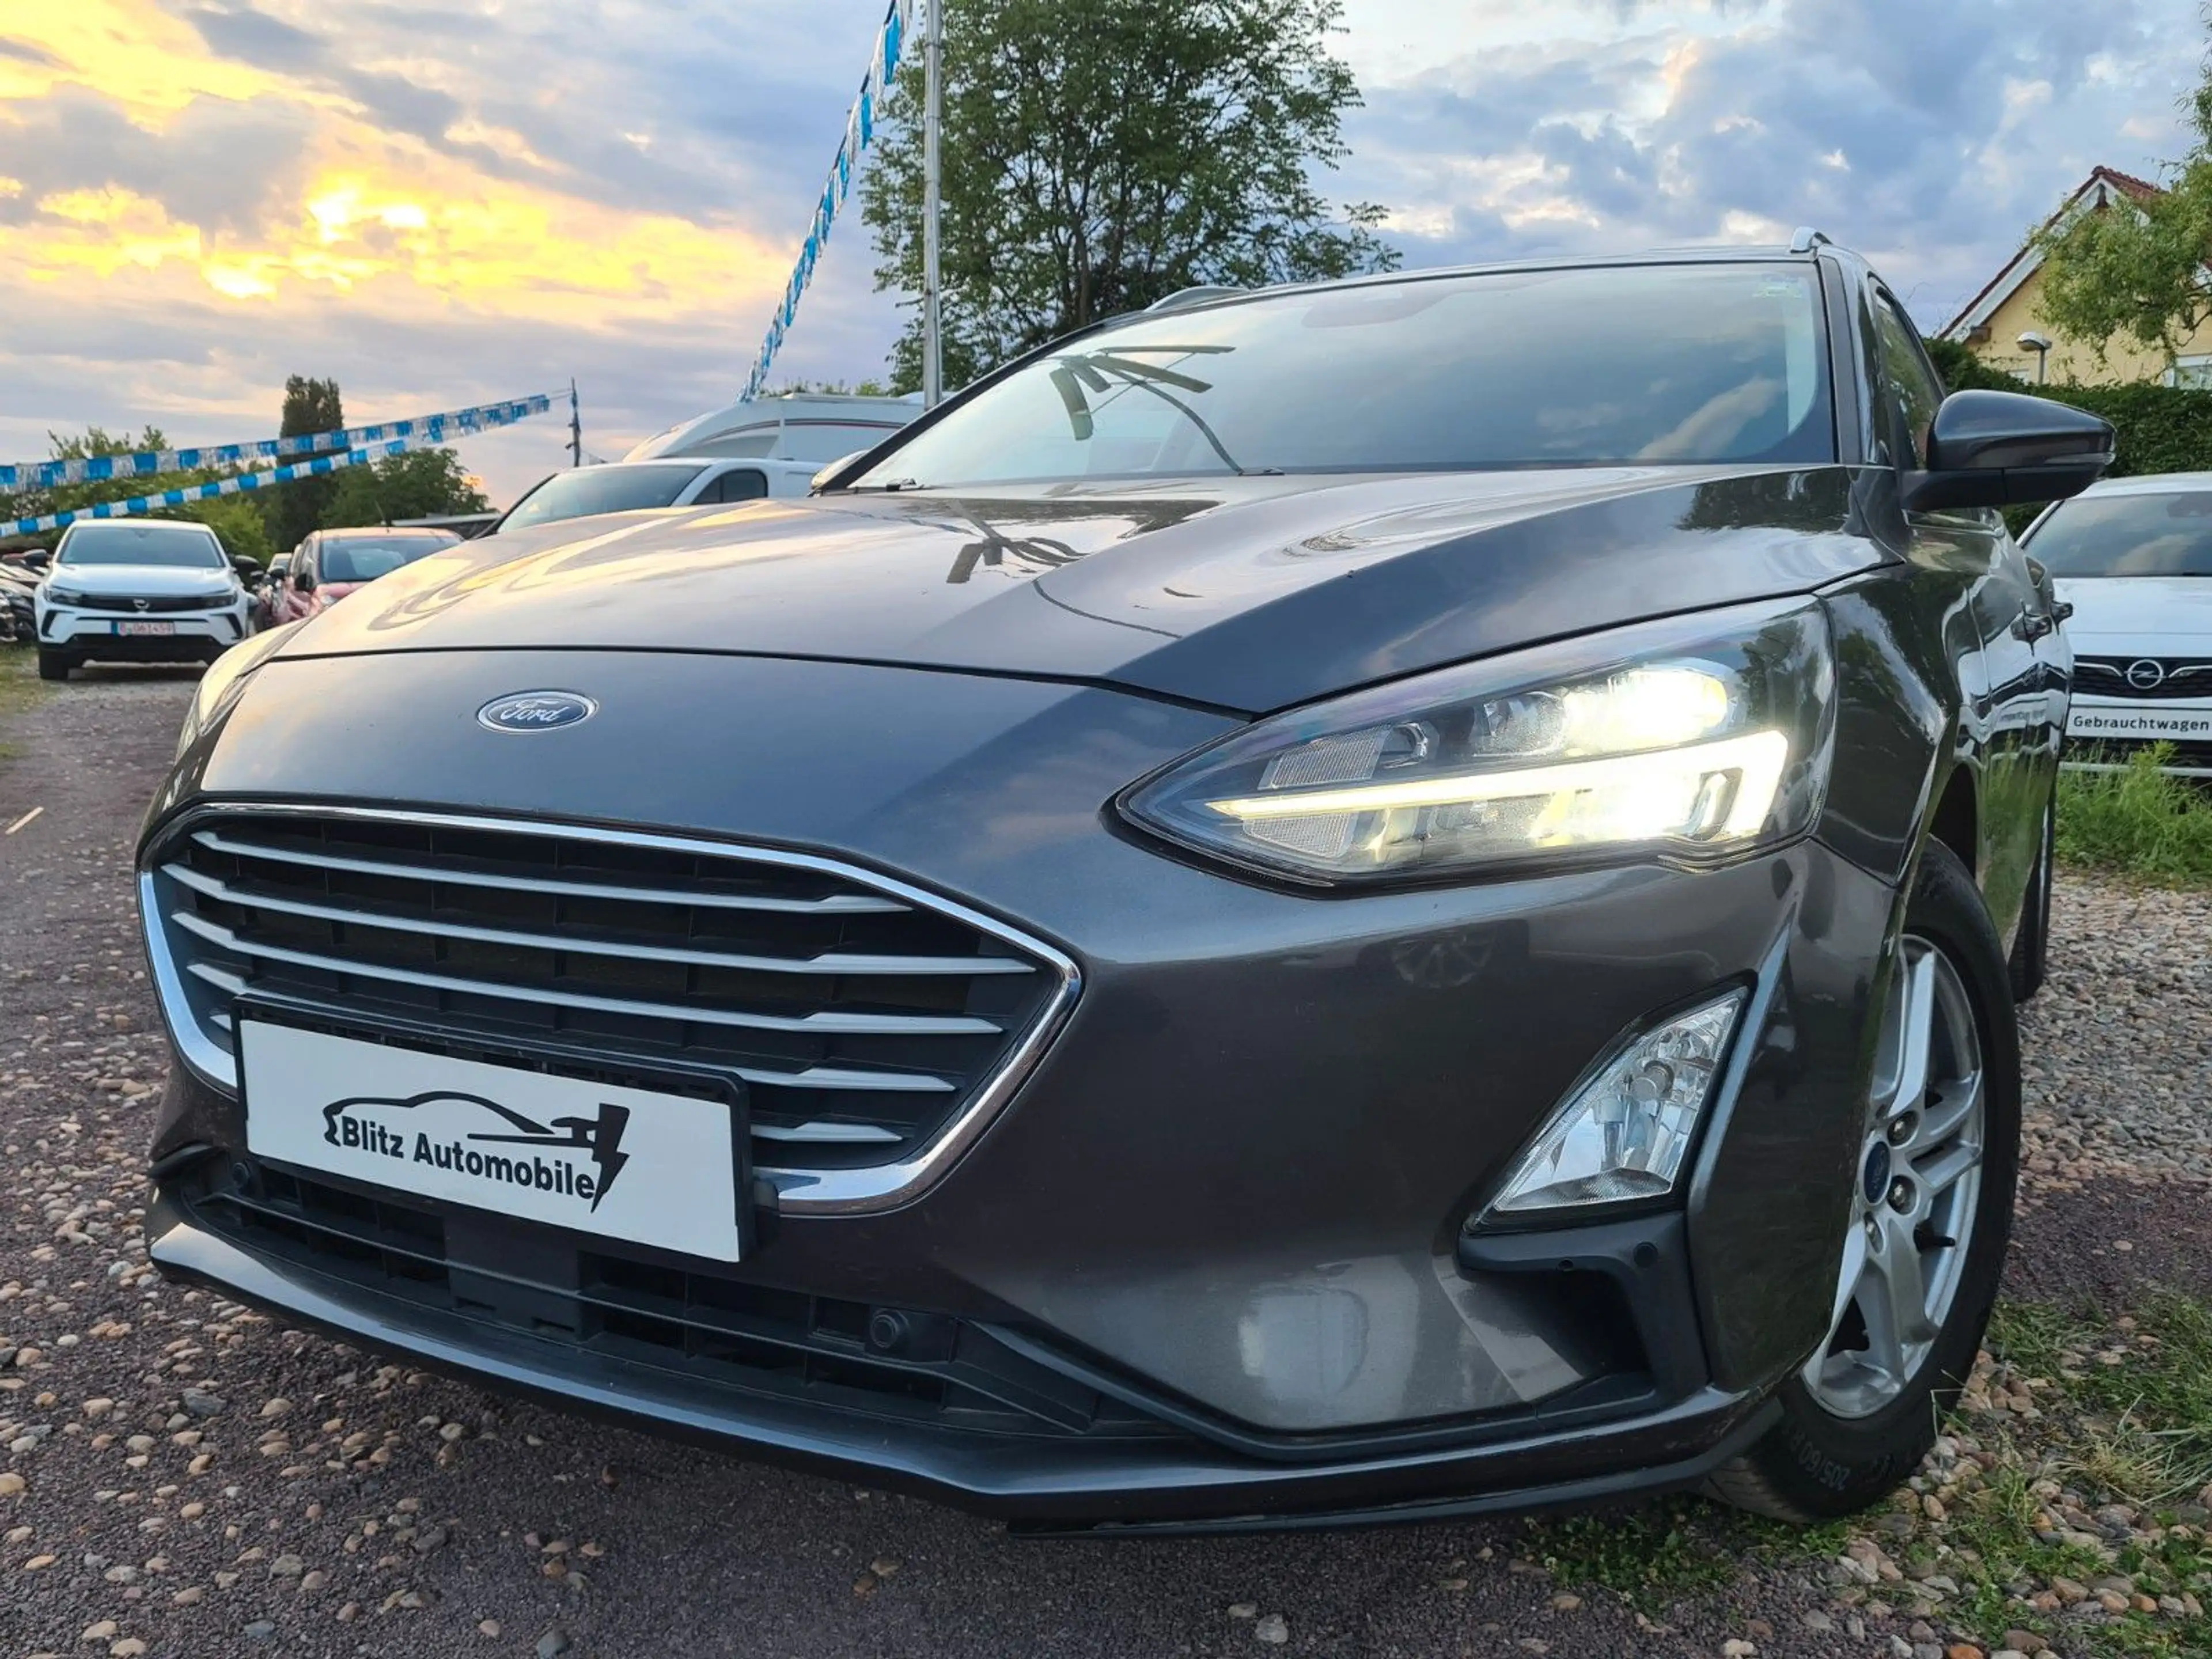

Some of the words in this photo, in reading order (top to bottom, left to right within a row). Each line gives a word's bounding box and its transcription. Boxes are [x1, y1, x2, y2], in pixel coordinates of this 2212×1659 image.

[500, 699, 569, 722] Ford
[2074, 716, 2209, 731] Gebrauchtwagen
[342, 1116, 403, 1158] Blitz
[413, 1132, 594, 1199] Automobile
